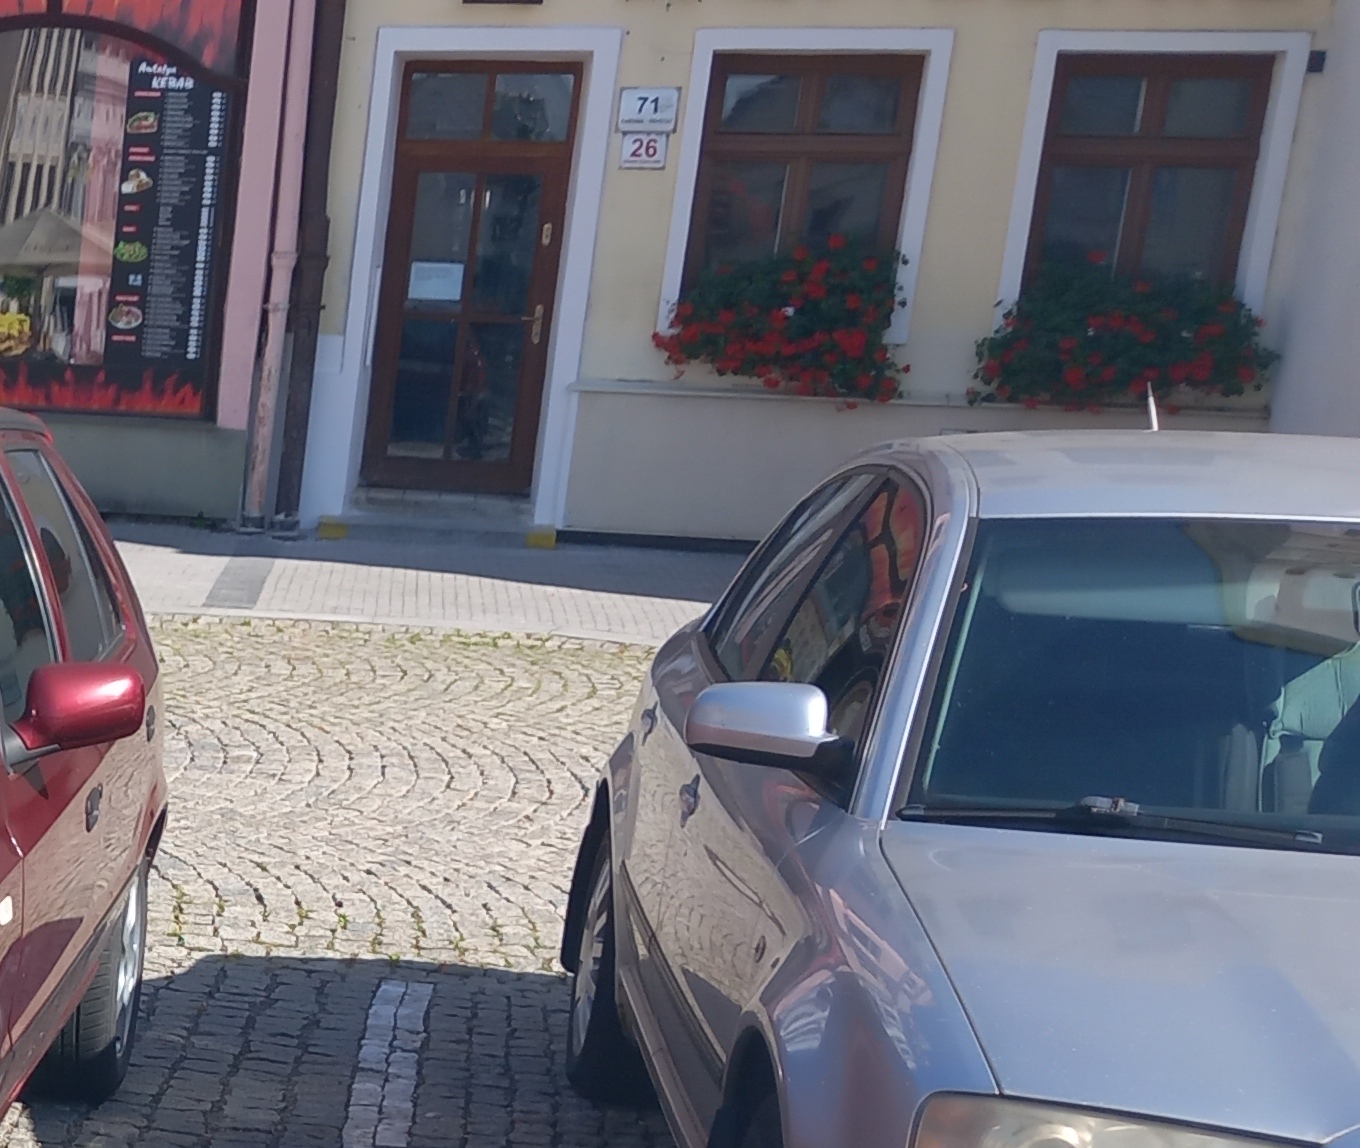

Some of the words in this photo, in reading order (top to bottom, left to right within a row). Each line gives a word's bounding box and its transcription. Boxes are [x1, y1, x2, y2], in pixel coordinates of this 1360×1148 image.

[151, 76, 195, 89] KEBAB
[636, 96, 660, 115] 71
[630, 138, 659, 158] 26
